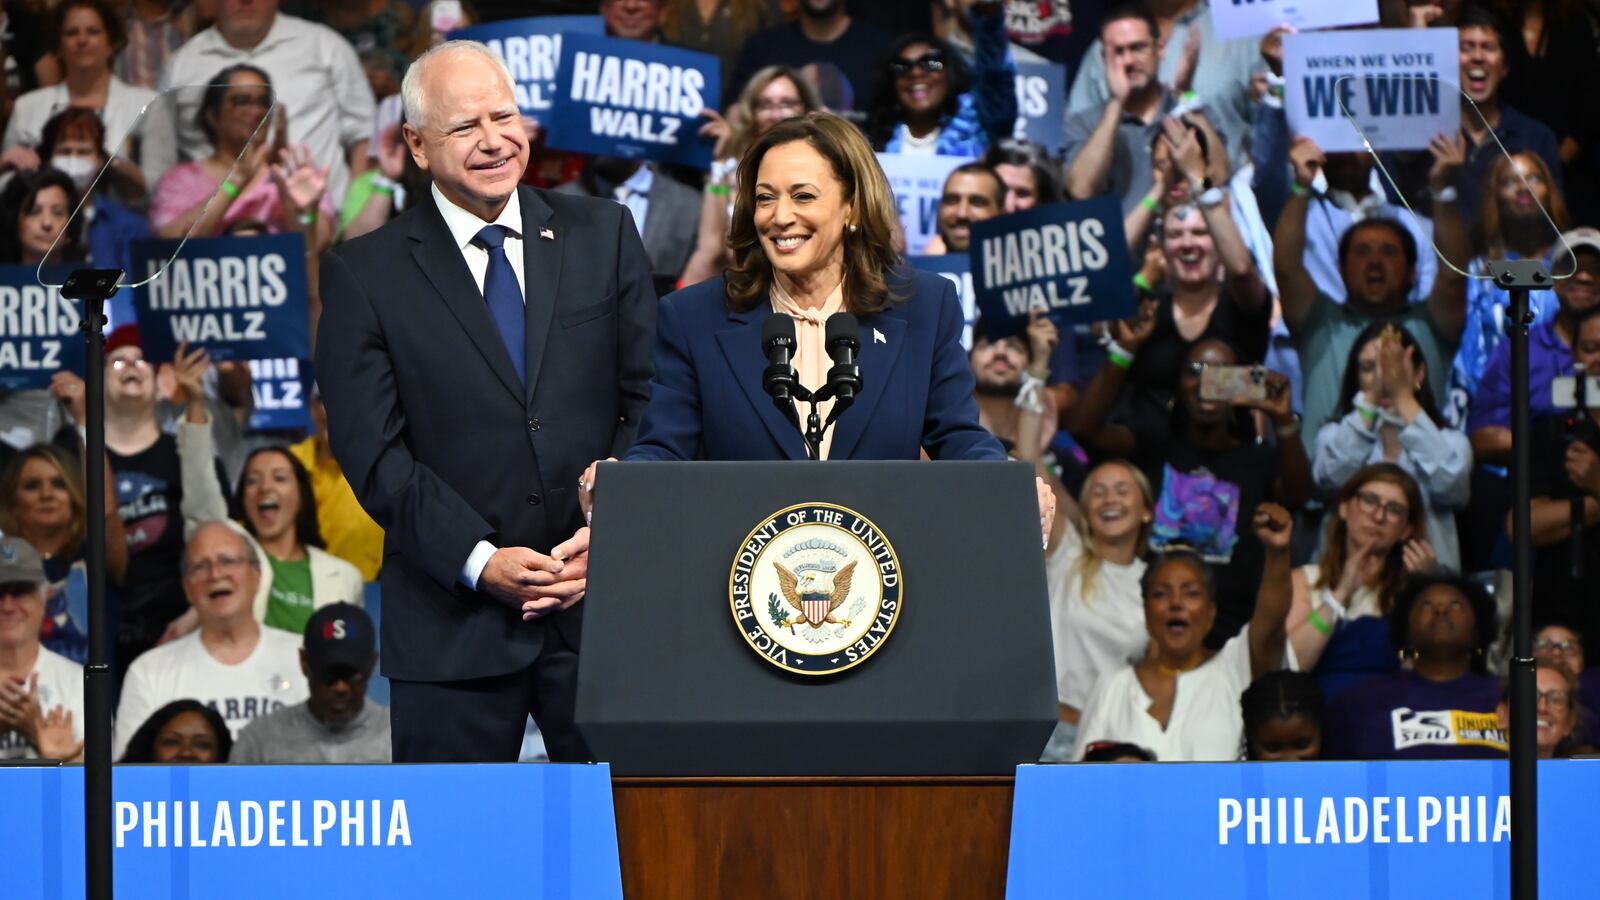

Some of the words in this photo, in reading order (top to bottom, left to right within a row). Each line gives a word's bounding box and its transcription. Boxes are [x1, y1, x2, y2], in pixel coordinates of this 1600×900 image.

[1306, 55, 1356, 69] WHEN
[1361, 54, 1387, 67] WE
[1392, 52, 1435, 66] VOTE
[516, 82, 556, 109] AL
[570, 52, 704, 118] HARRIS
[1303, 75, 1357, 119] WE
[1363, 71, 1440, 117] WIN
[590, 106, 682, 145] WALZ
[982, 217, 1109, 290] HARRIS
[147, 253, 288, 310] HARRIS
[1002, 275, 1092, 317] WALZ
[169, 311, 267, 343] WALZ
[786, 510, 807, 526] OF
[813, 509, 844, 525] THE
[733, 519, 780, 621] PRESIDENT
[850, 518, 898, 588] UNITED
[748, 625, 788, 666] VICE
[845, 598, 897, 662] STATES
[115, 800, 412, 848] PHILADELPHIA
[1218, 795, 1511, 845] PHILADELPHIA
